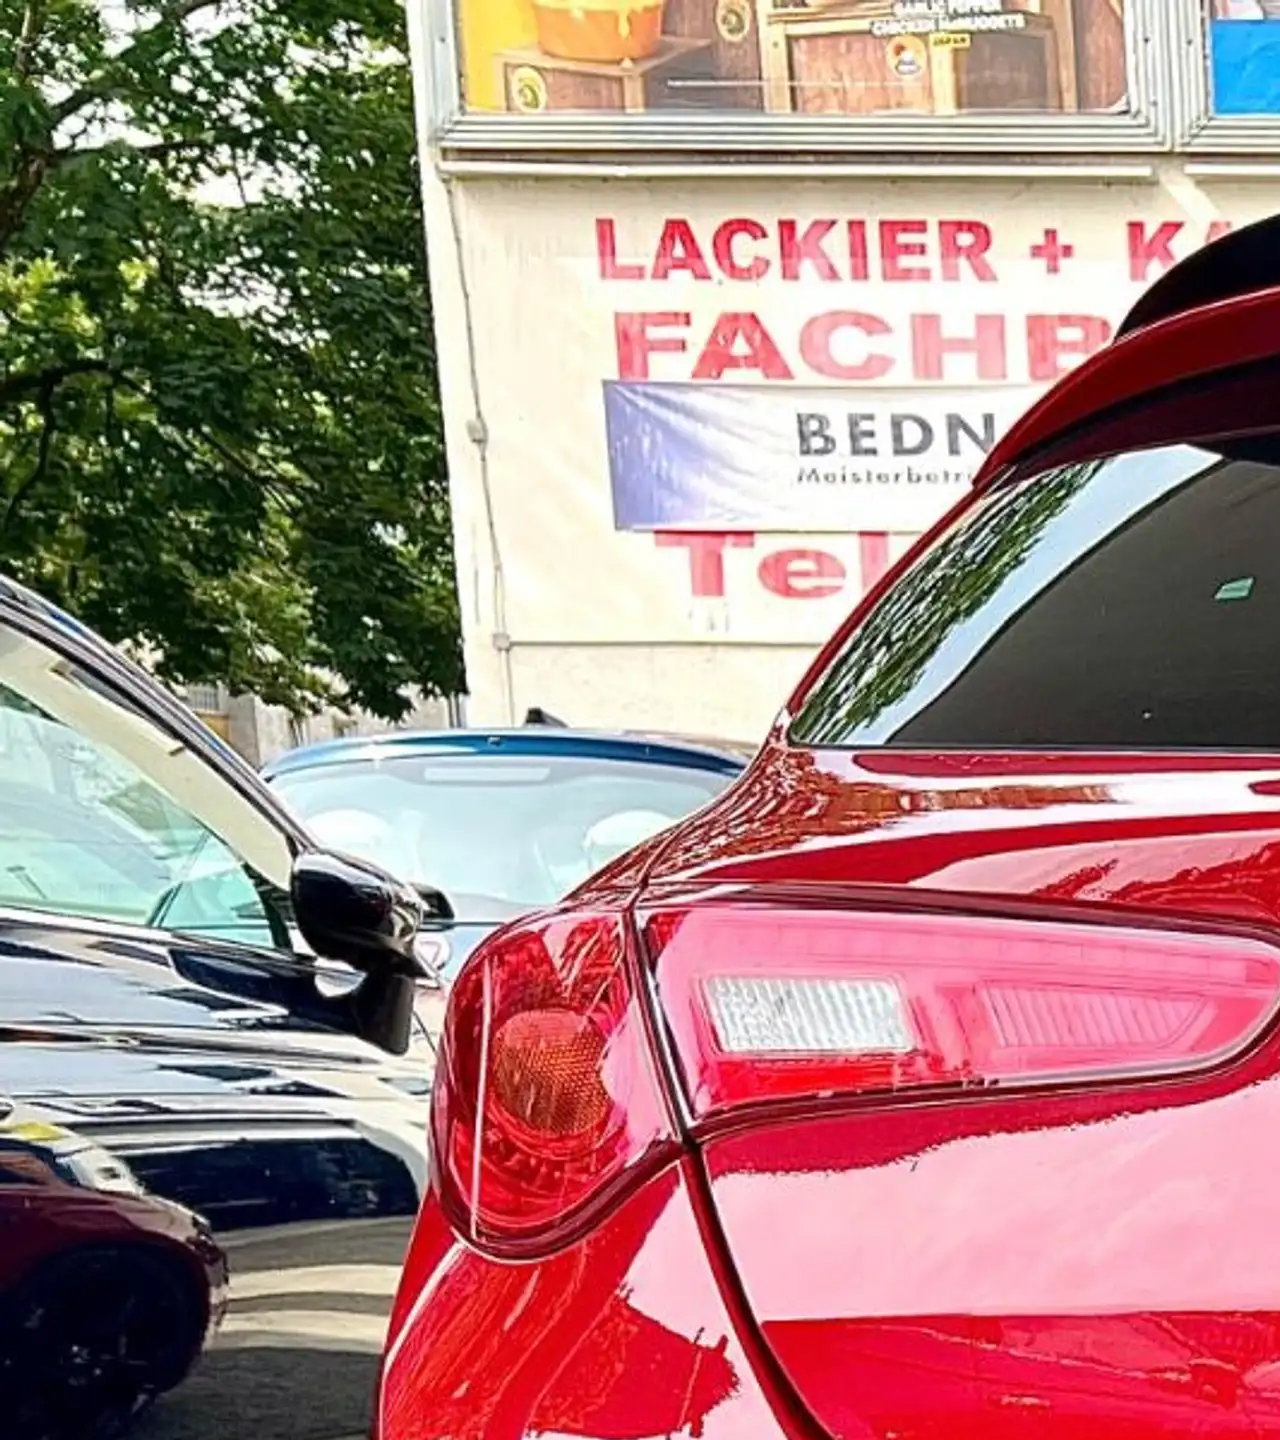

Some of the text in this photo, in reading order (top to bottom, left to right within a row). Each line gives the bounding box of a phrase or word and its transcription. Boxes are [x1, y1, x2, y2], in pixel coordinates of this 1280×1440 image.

[595, 218, 998, 282] LACKIER
[1030, 228, 1075, 274] +
[796, 412, 995, 457] BEDN
